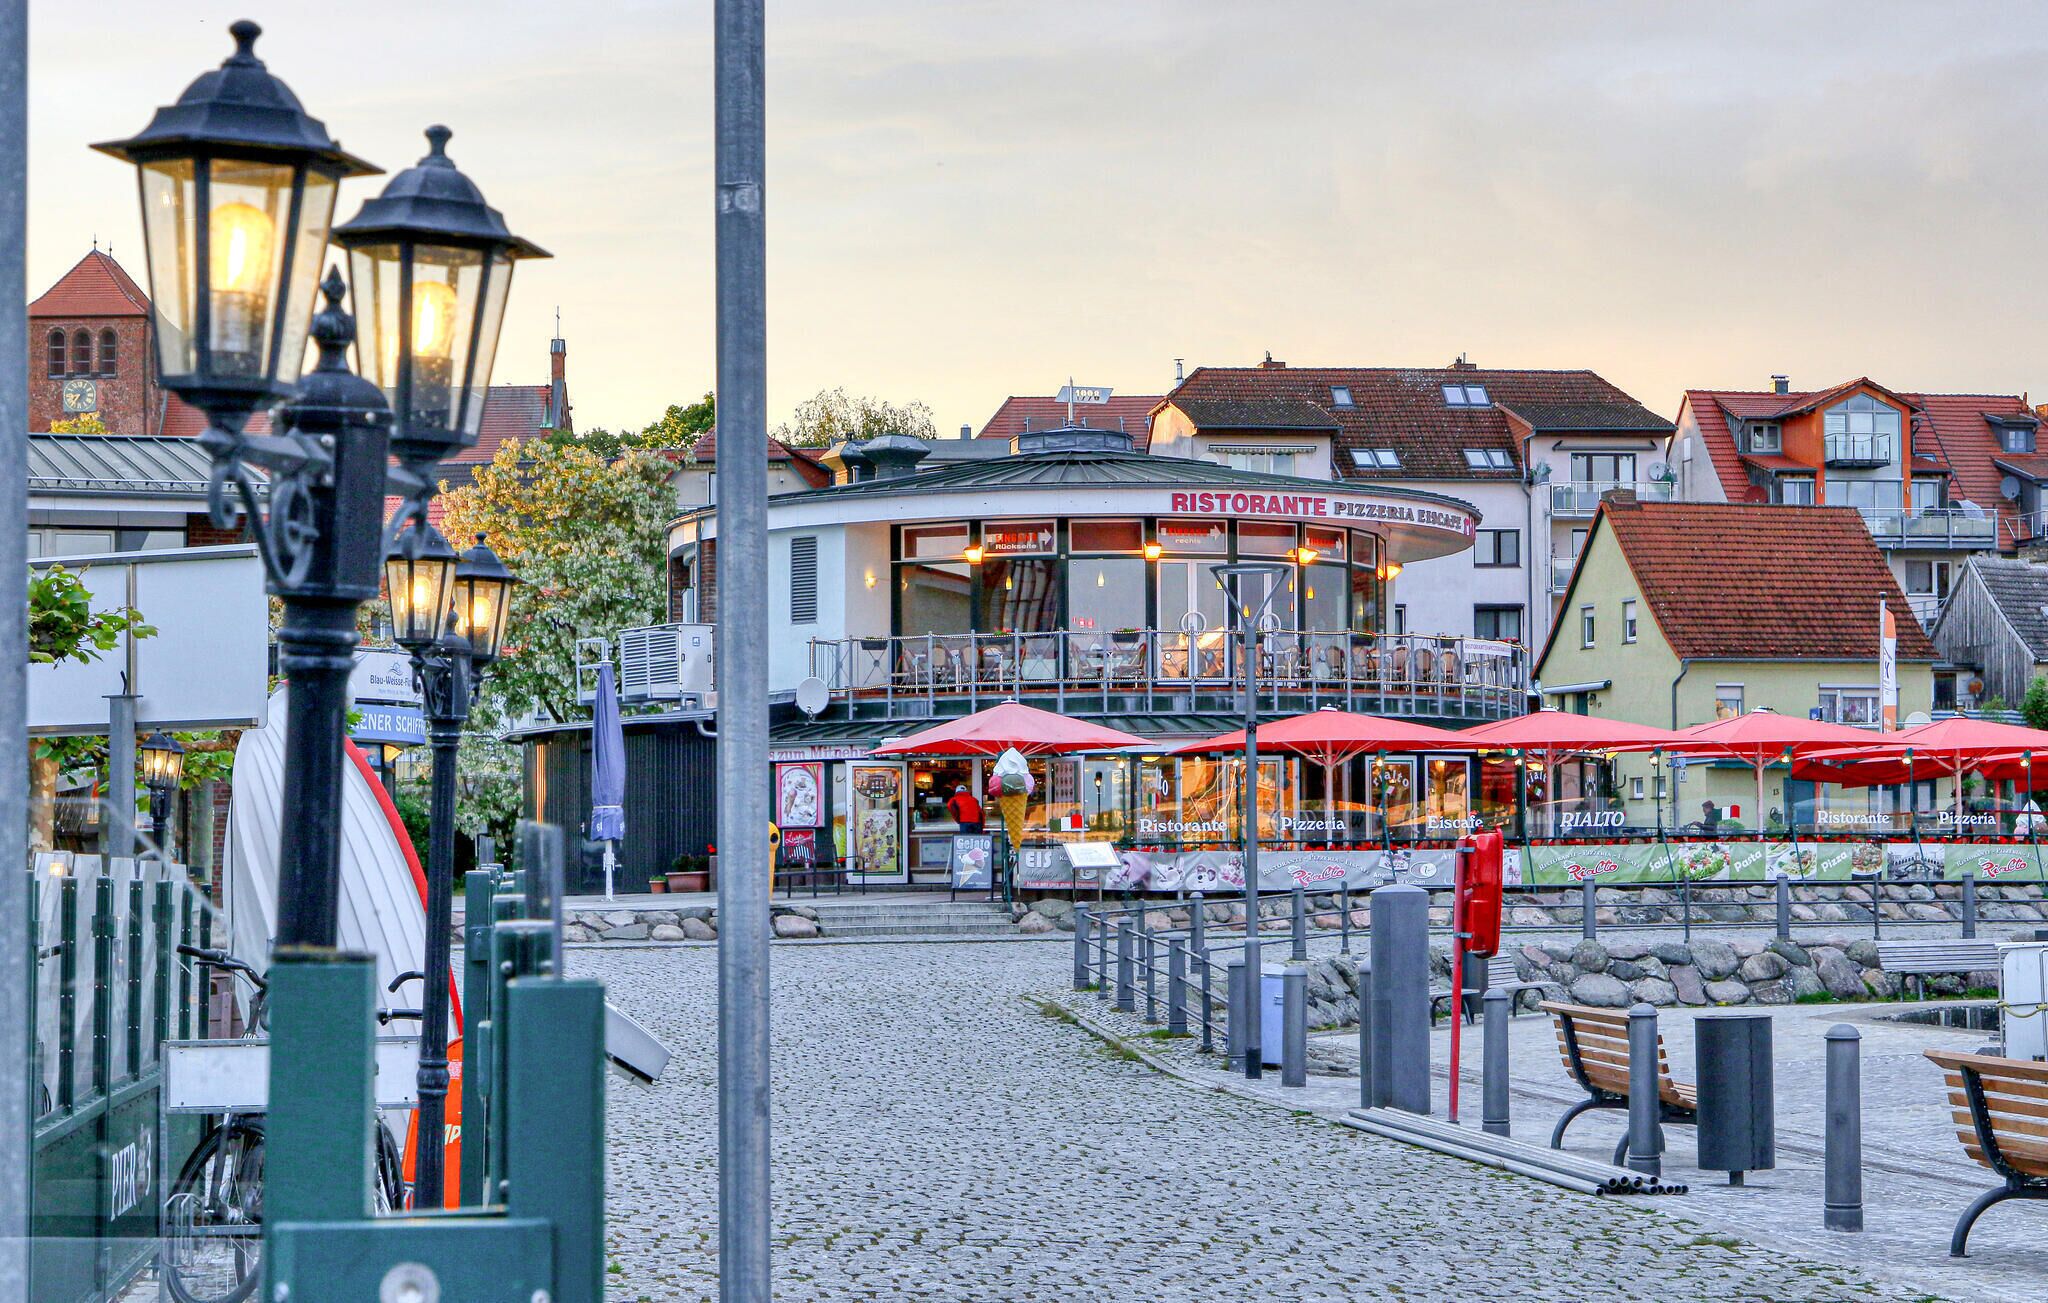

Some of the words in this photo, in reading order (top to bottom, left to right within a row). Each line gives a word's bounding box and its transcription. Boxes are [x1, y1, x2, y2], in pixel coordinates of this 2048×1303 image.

[1171, 492, 1327, 517] RISTORANTE
[1333, 501, 1415, 522] PIZZERIA
[1139, 818, 1228, 833] Ristorante
[1280, 816, 1346, 831] Pizzeria
[1559, 811, 1625, 828] RIALTO
[1817, 810, 1890, 825] Ristorante
[1938, 811, 1997, 825] Pizzeria
[956, 838, 991, 850] Gelato
[1025, 851, 1052, 868] EIS
[1733, 850, 1763, 873] Pasta
[1820, 851, 1848, 872] Pizza
[1981, 857, 2028, 878] Rialto
[1292, 865, 1346, 887] Rialto
[1567, 858, 1619, 881] Rialto
[111, 1142, 136, 1222] PIER
